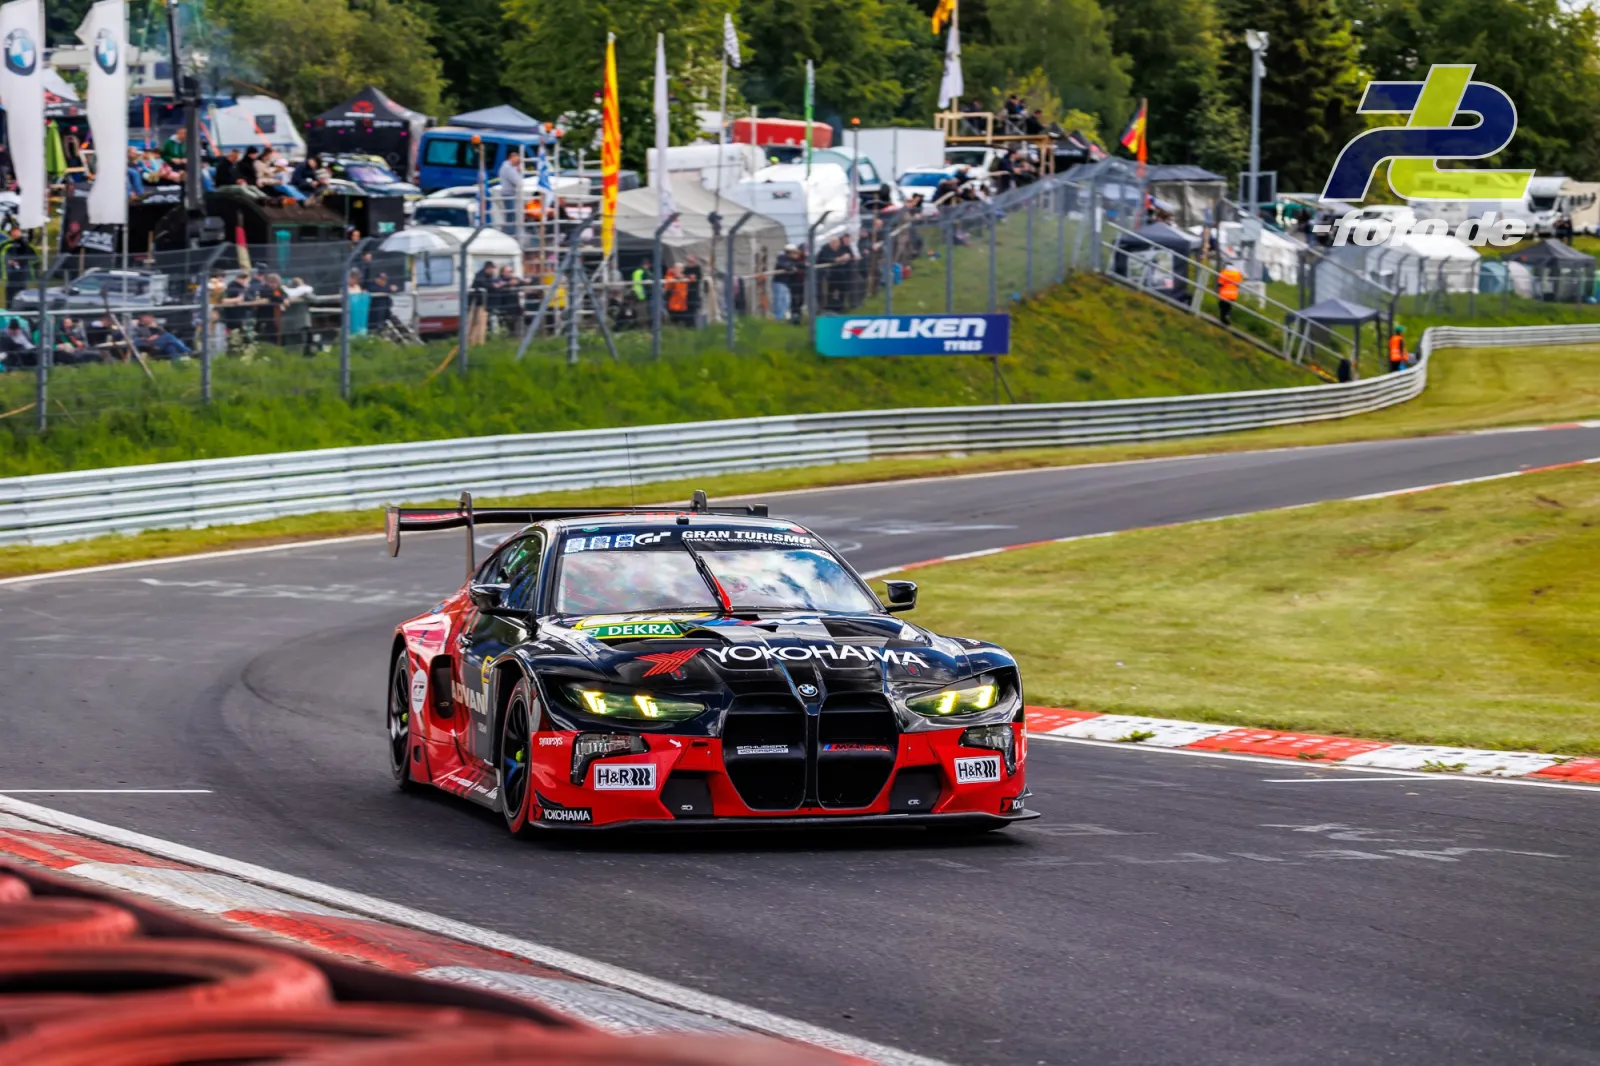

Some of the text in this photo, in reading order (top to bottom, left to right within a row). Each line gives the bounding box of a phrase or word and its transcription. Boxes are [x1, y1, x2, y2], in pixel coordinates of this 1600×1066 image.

[841, 318, 988, 339] FALKEN
[682, 530, 813, 544] GRAN TURISMO
[608, 624, 676, 636] DEKRA
[705, 645, 930, 669] YOKOHAMA
[451, 679, 489, 716] ADVAN
[597, 769, 630, 784] H&R
[958, 762, 983, 778] H&R
[543, 808, 590, 821] YOKOHAMA
